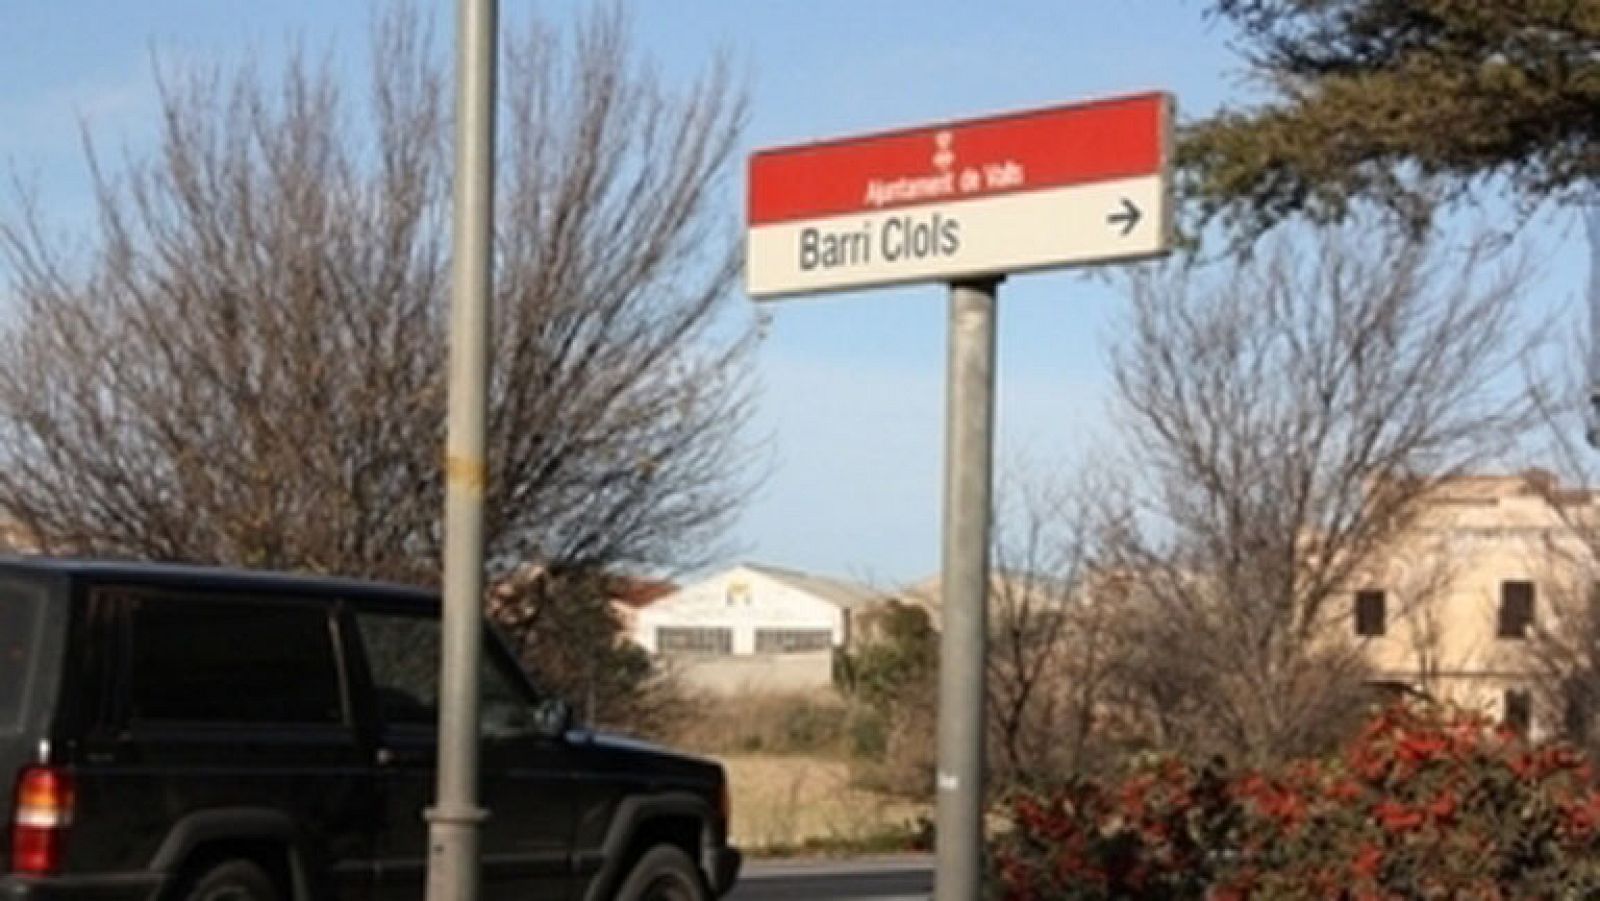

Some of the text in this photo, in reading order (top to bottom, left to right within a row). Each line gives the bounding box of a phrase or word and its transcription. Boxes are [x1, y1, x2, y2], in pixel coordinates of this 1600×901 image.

[865, 172, 954, 206] Ajuntament
[960, 168, 980, 192] de
[800, 213, 960, 271] Barri Clols
